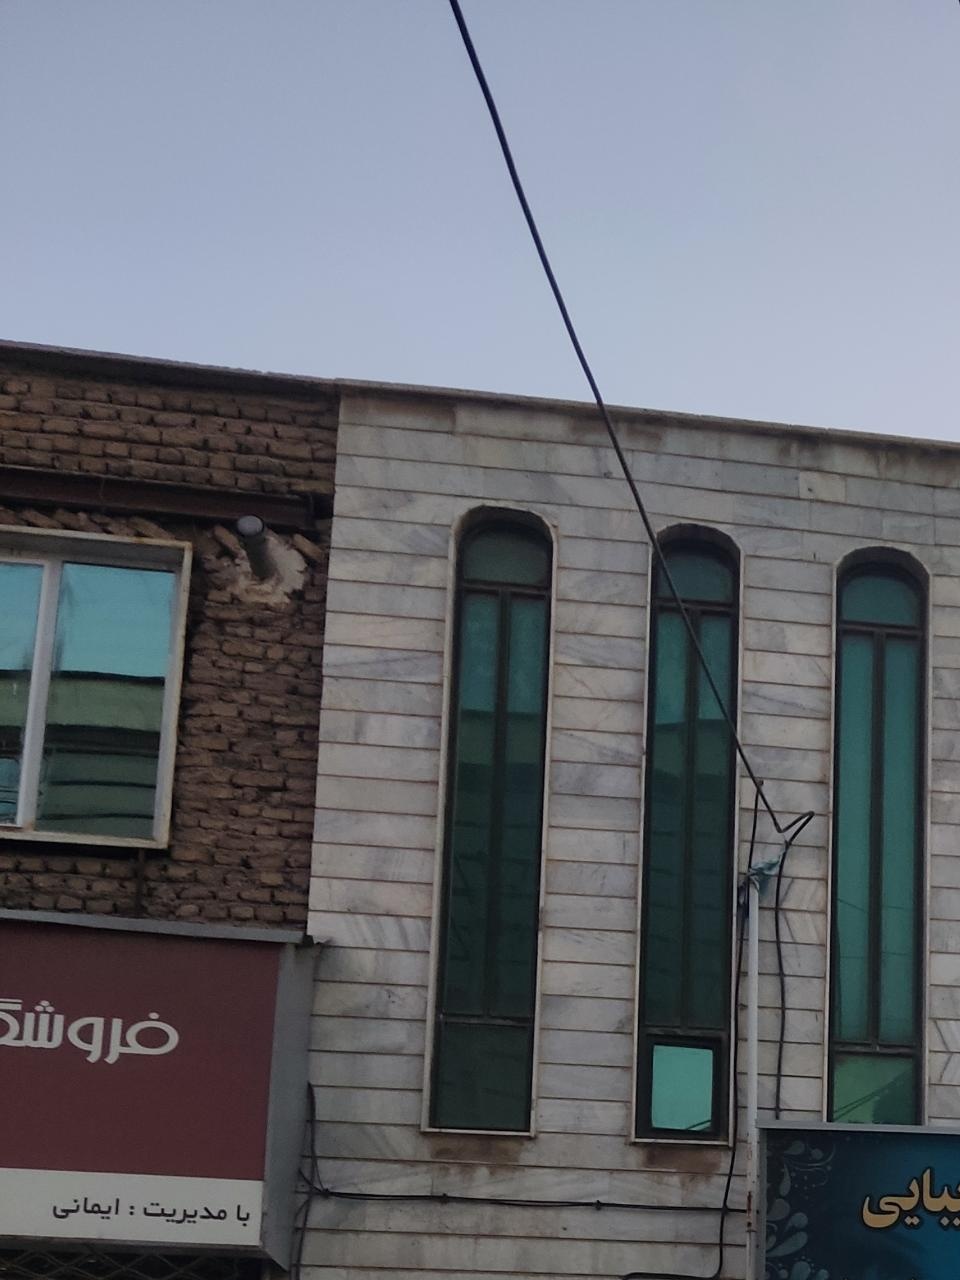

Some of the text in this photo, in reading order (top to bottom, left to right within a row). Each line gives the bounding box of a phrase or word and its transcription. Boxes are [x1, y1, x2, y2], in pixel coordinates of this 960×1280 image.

[52, 1198, 120, 1220] ایمانی
[143, 1201, 227, 1224] مدیریت
[236, 1204, 250, 1226] با
